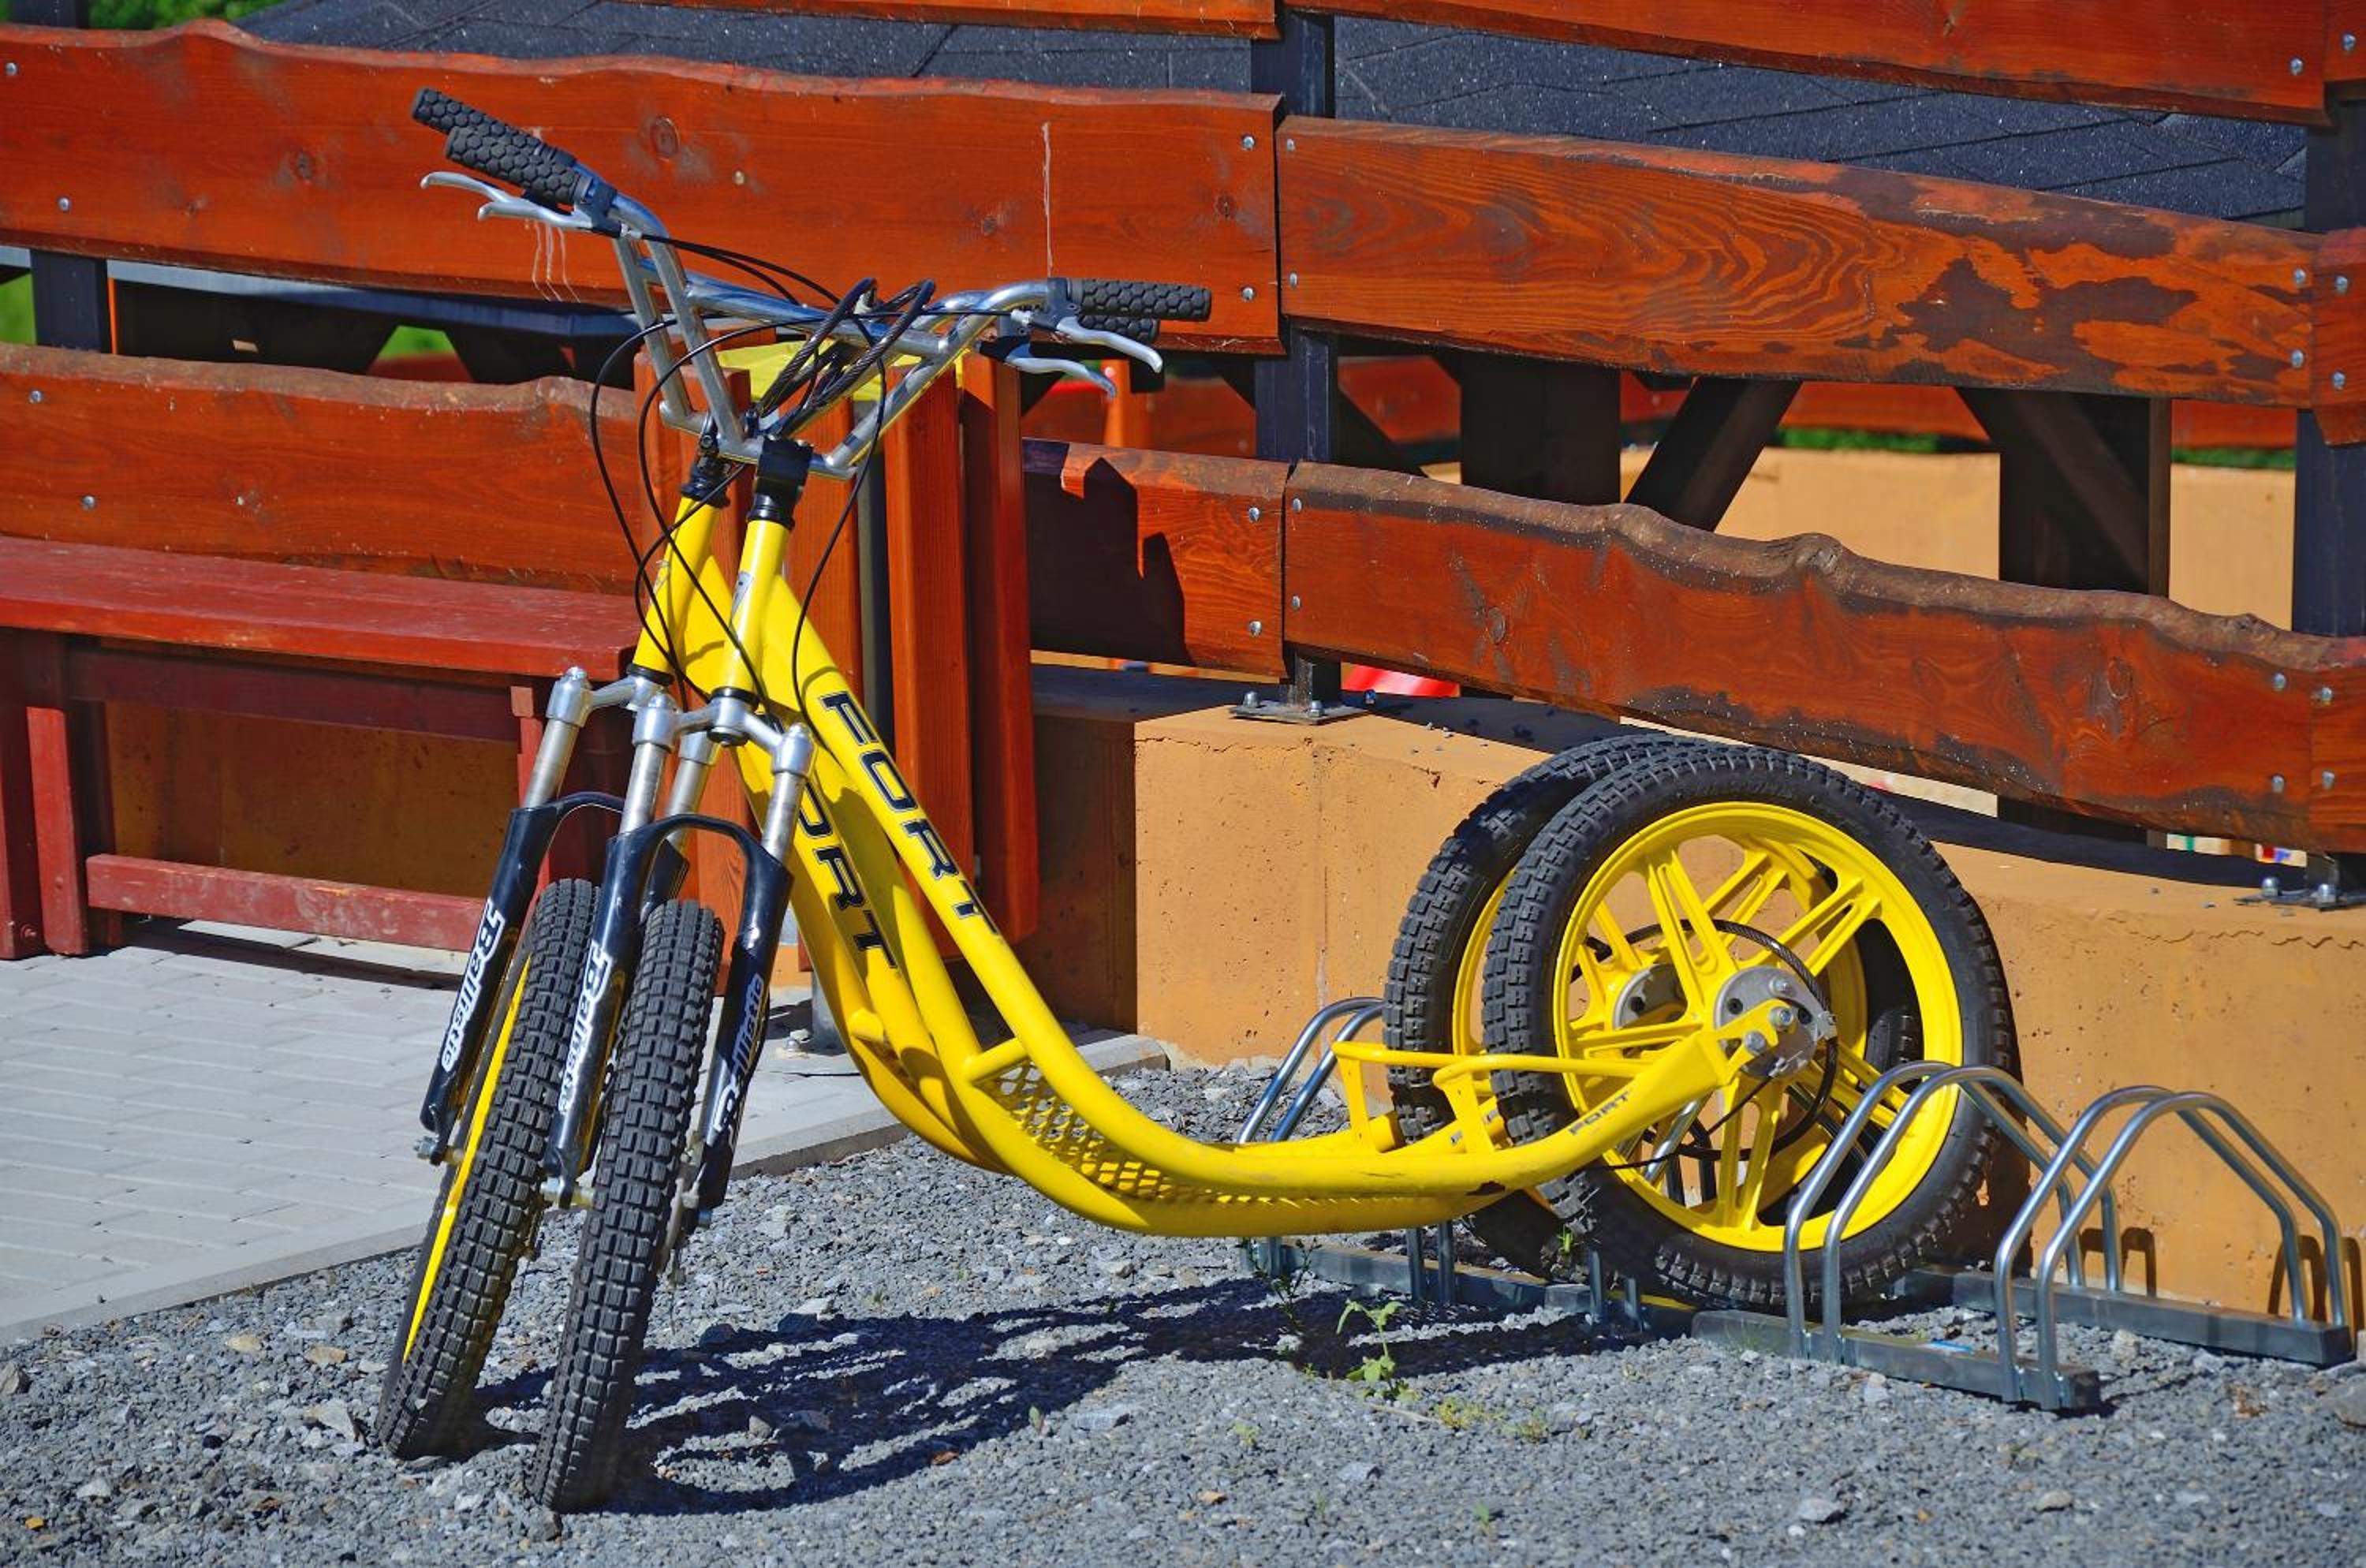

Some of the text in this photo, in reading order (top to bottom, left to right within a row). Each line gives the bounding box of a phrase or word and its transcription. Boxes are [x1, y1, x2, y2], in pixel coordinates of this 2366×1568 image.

[820, 690, 998, 934] FORT
[442, 896, 505, 1071] Ballistic
[1569, 1092, 1629, 1135] FORT
